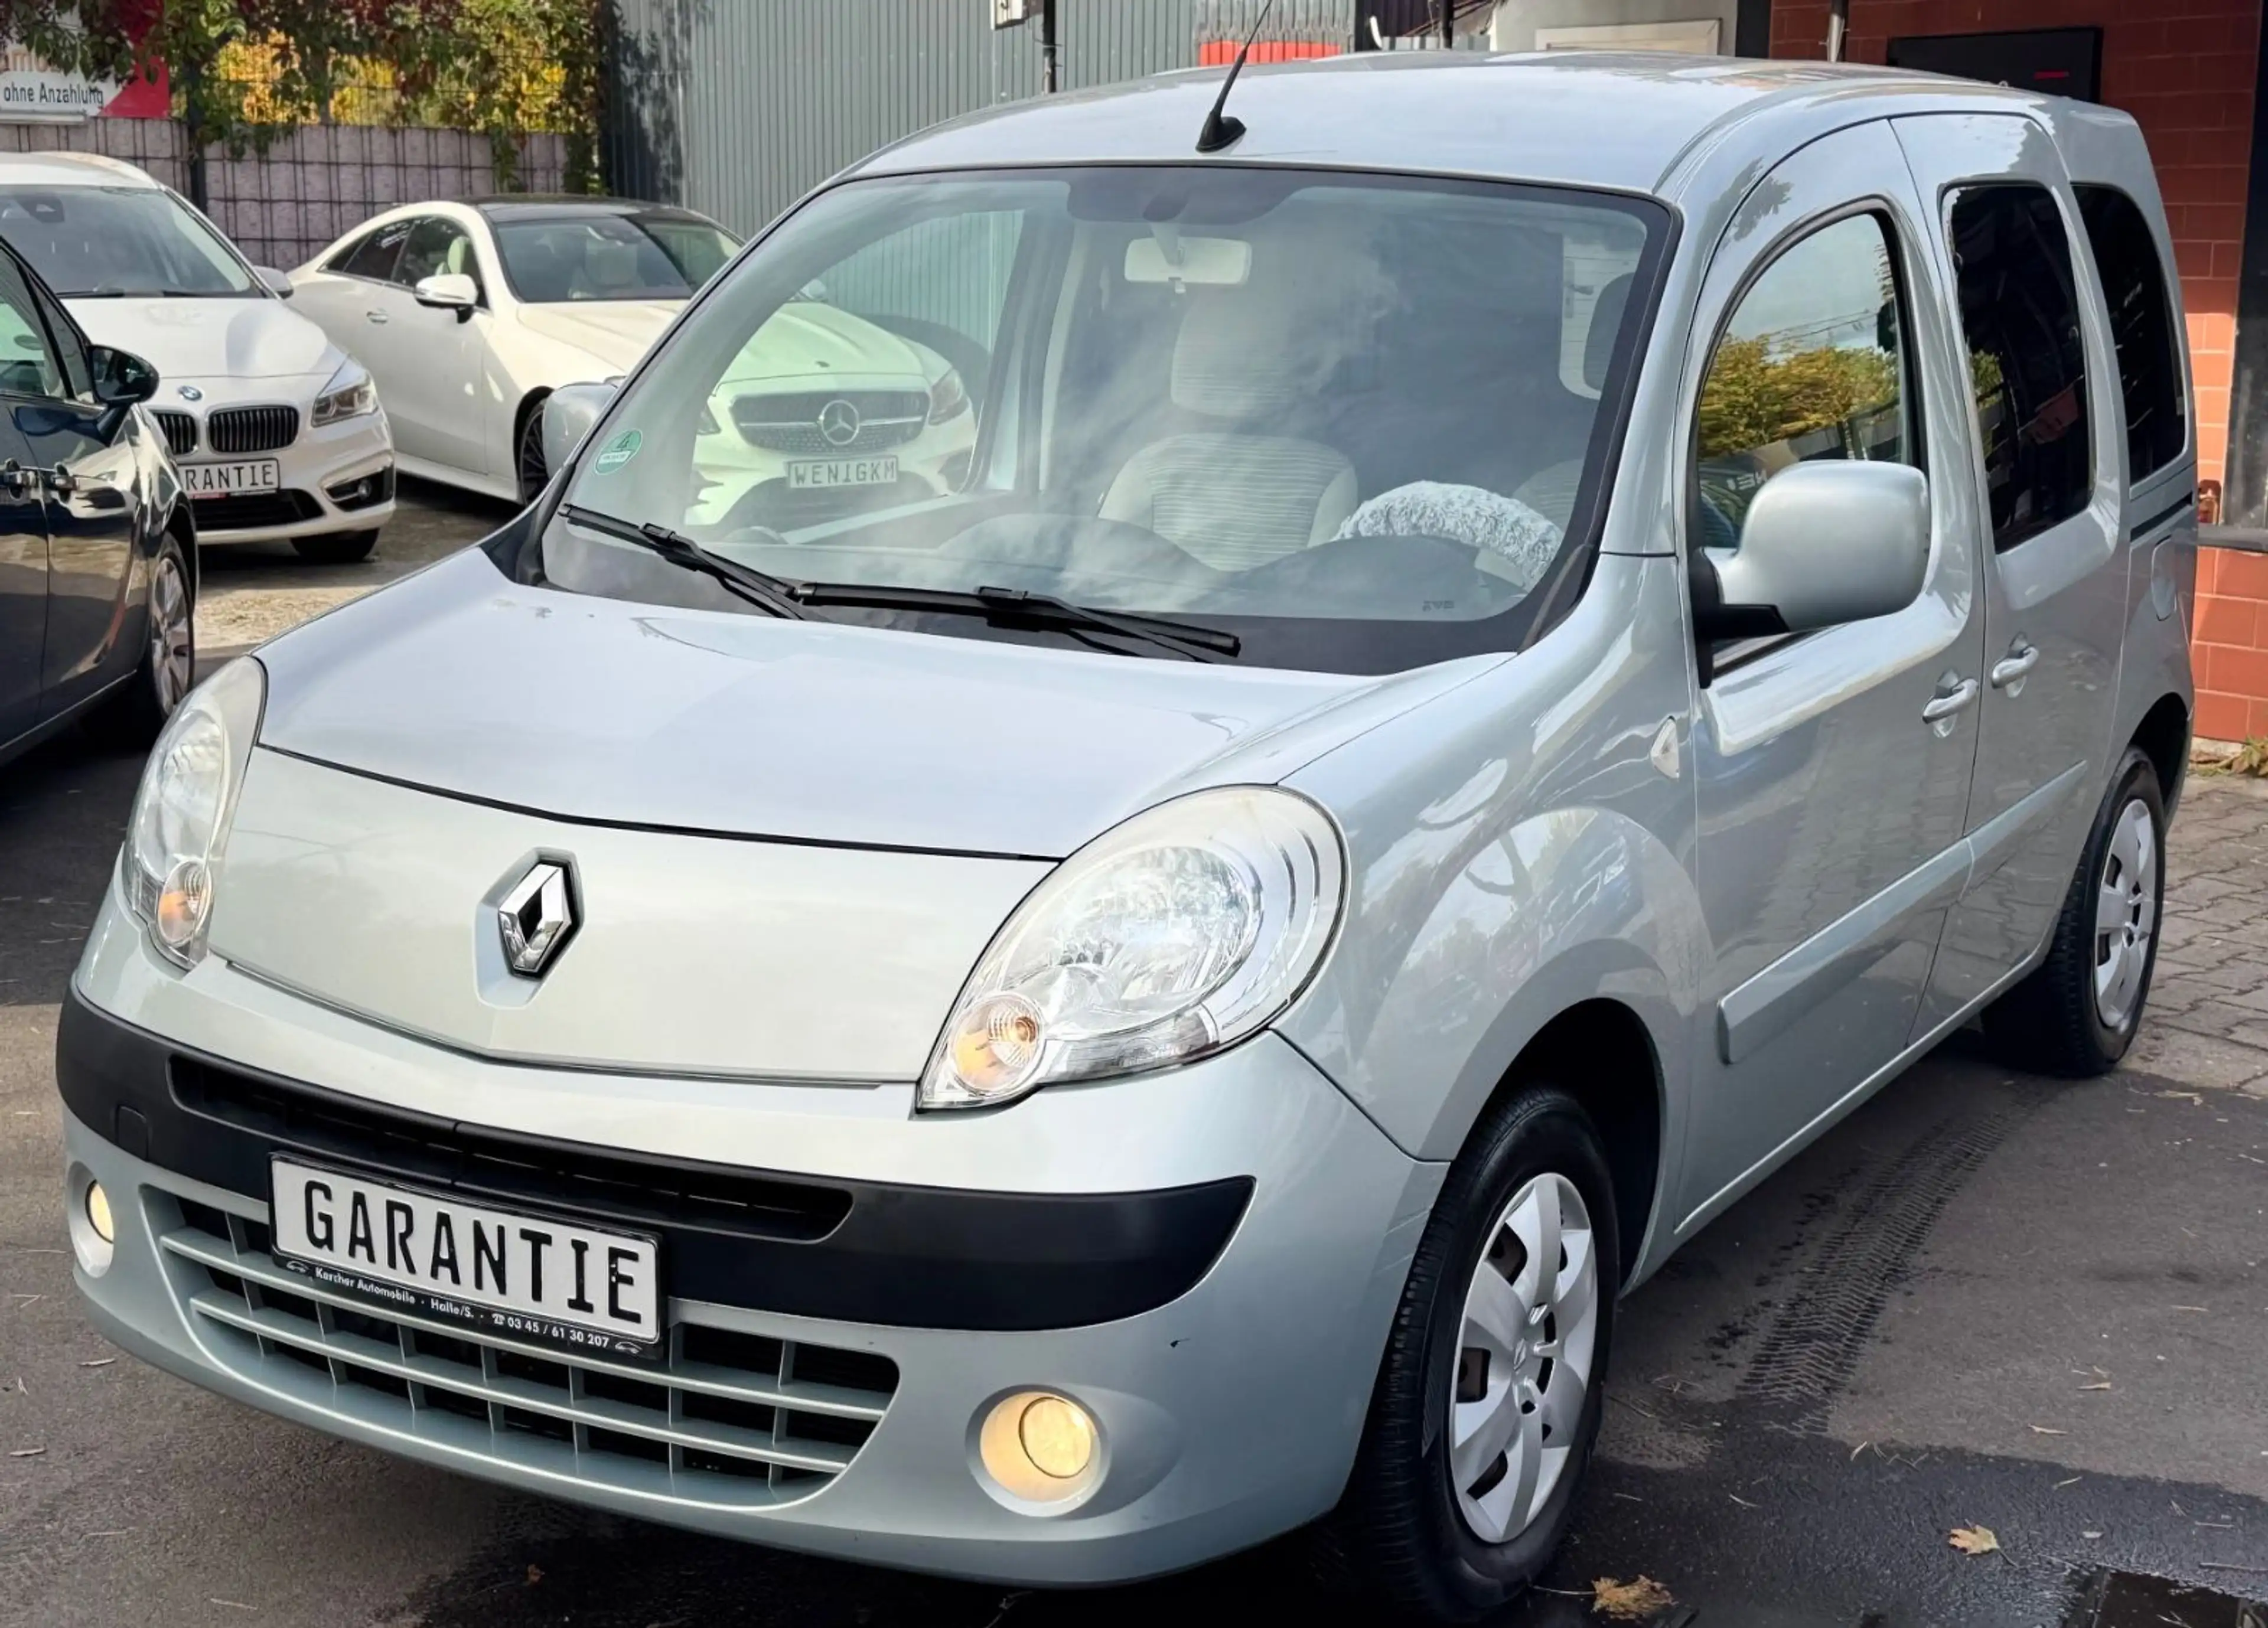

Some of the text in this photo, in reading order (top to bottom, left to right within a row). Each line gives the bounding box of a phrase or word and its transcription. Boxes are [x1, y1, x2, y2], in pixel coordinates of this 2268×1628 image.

[4, 81, 34, 102] ohne
[794, 461, 895, 487] WENIGKM
[304, 1180, 641, 1324] GARANTIE
[356, 1278, 415, 1304] Automobile
[507, 1317, 521, 1329] 03
[524, 1320, 539, 1333] 45
[552, 1326, 565, 1339] 61
[569, 1330, 584, 1343] 30
[588, 1333, 609, 1348] 207
